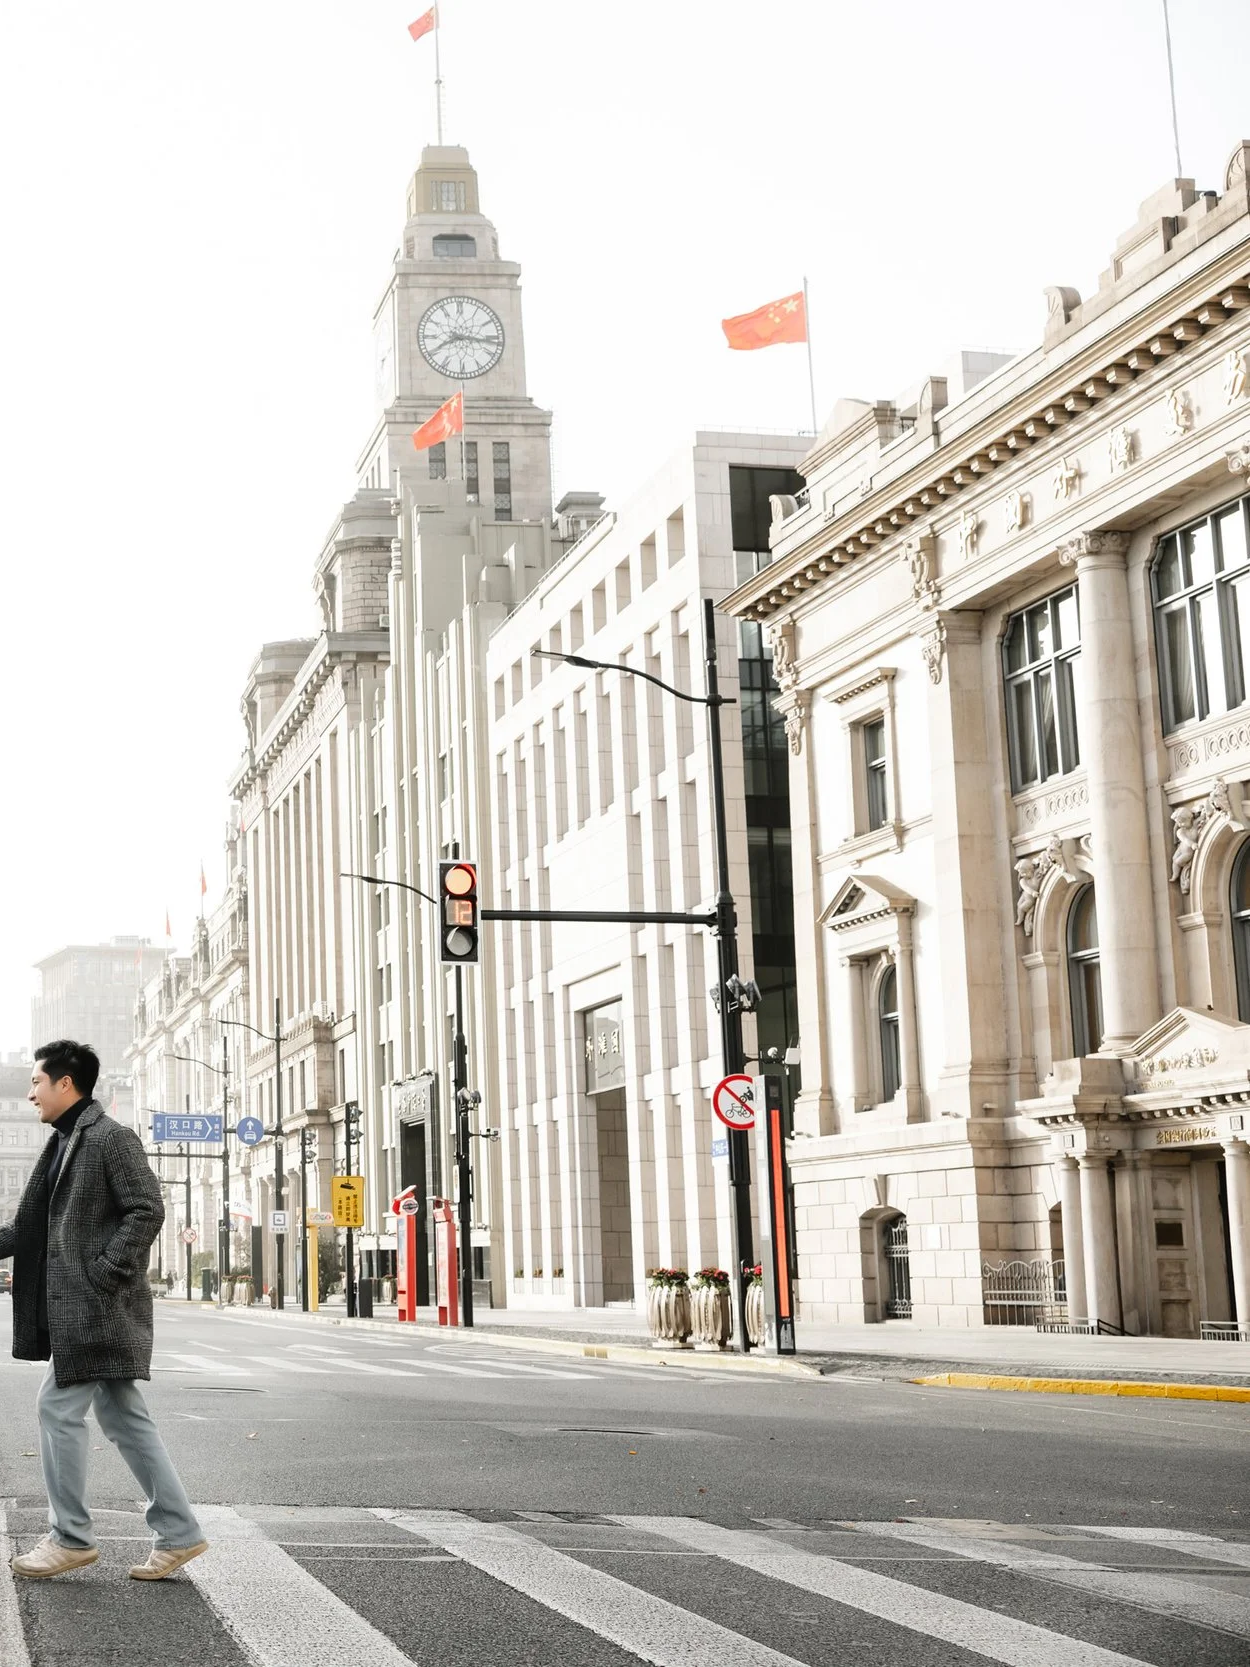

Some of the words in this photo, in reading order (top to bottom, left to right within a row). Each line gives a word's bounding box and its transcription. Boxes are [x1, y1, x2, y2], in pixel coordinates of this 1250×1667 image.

[455, 901, 472, 924] 12
[169, 1120, 203, 1129] 汉口路
